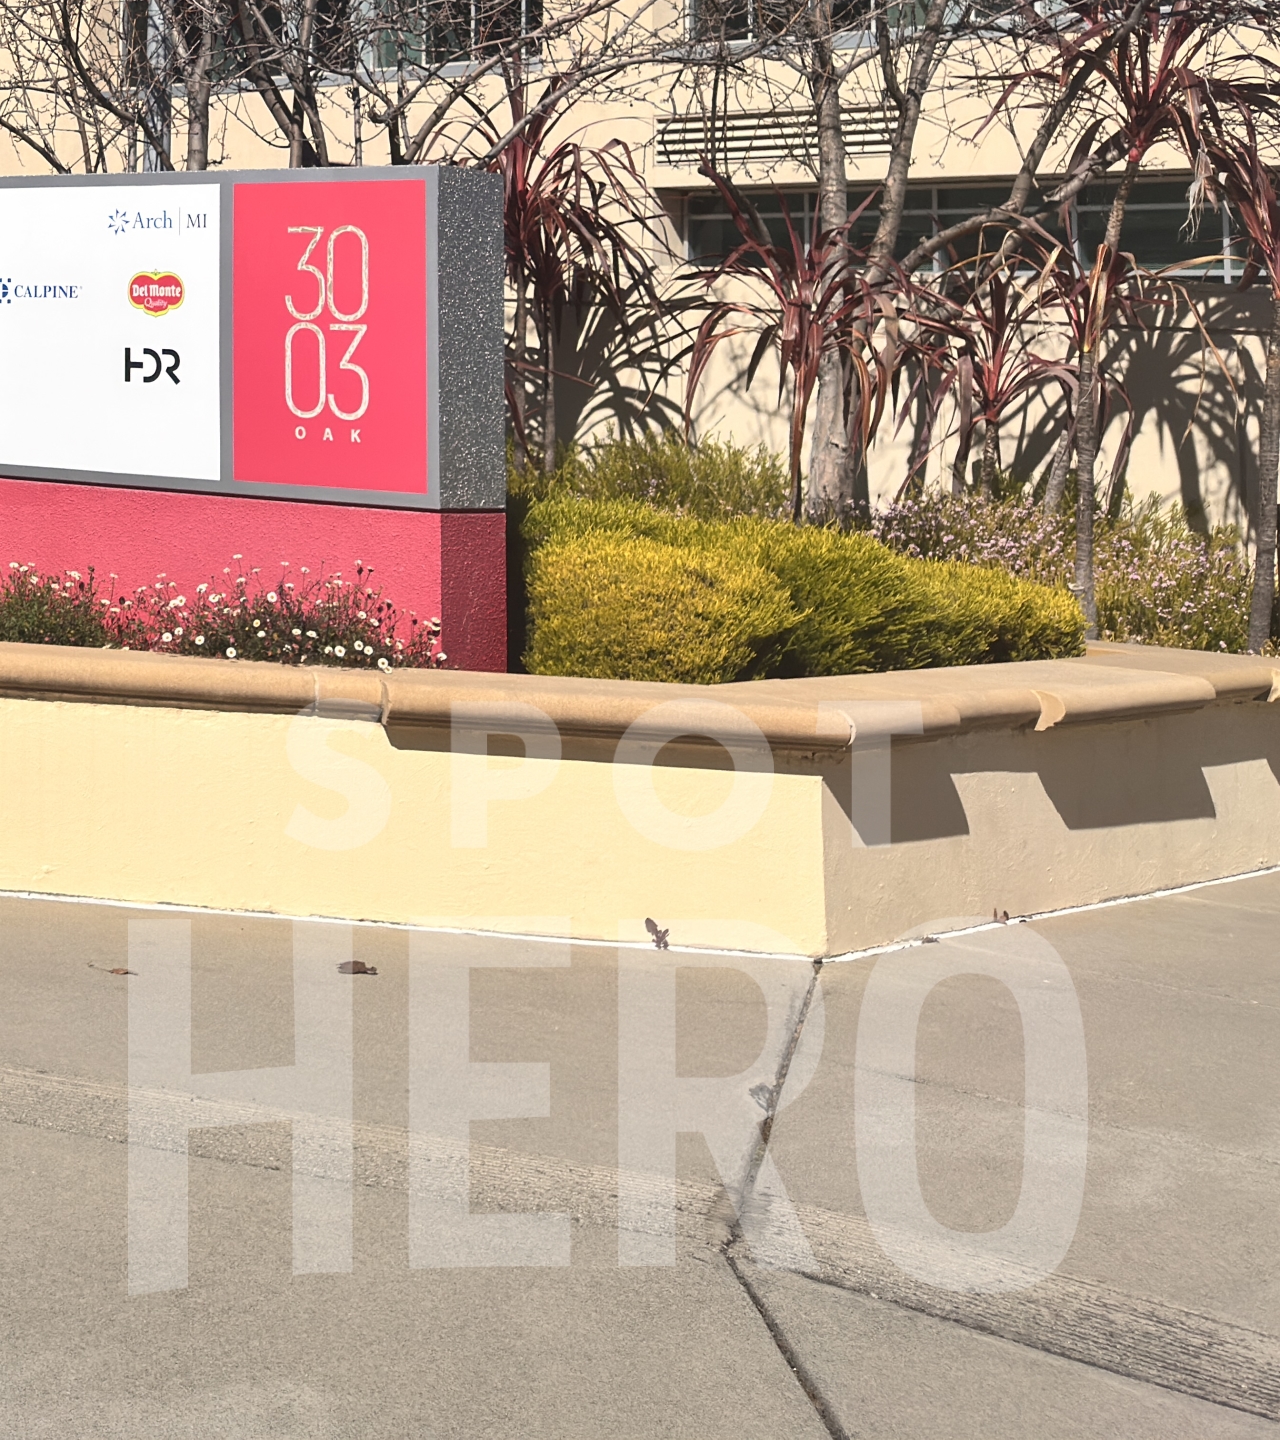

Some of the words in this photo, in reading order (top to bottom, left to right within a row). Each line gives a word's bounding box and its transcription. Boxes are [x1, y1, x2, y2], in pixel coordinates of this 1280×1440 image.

[132, 210, 173, 229] Arch
[186, 213, 207, 229] MI
[285, 224, 369, 321] 30
[13, 284, 80, 299] CALPINE
[132, 284, 148, 297] Del
[149, 284, 181, 297] Monte
[144, 297, 168, 308] Quality
[124, 347, 181, 385] HDR
[285, 321, 369, 421] 03
[295, 426, 361, 443] OAK
